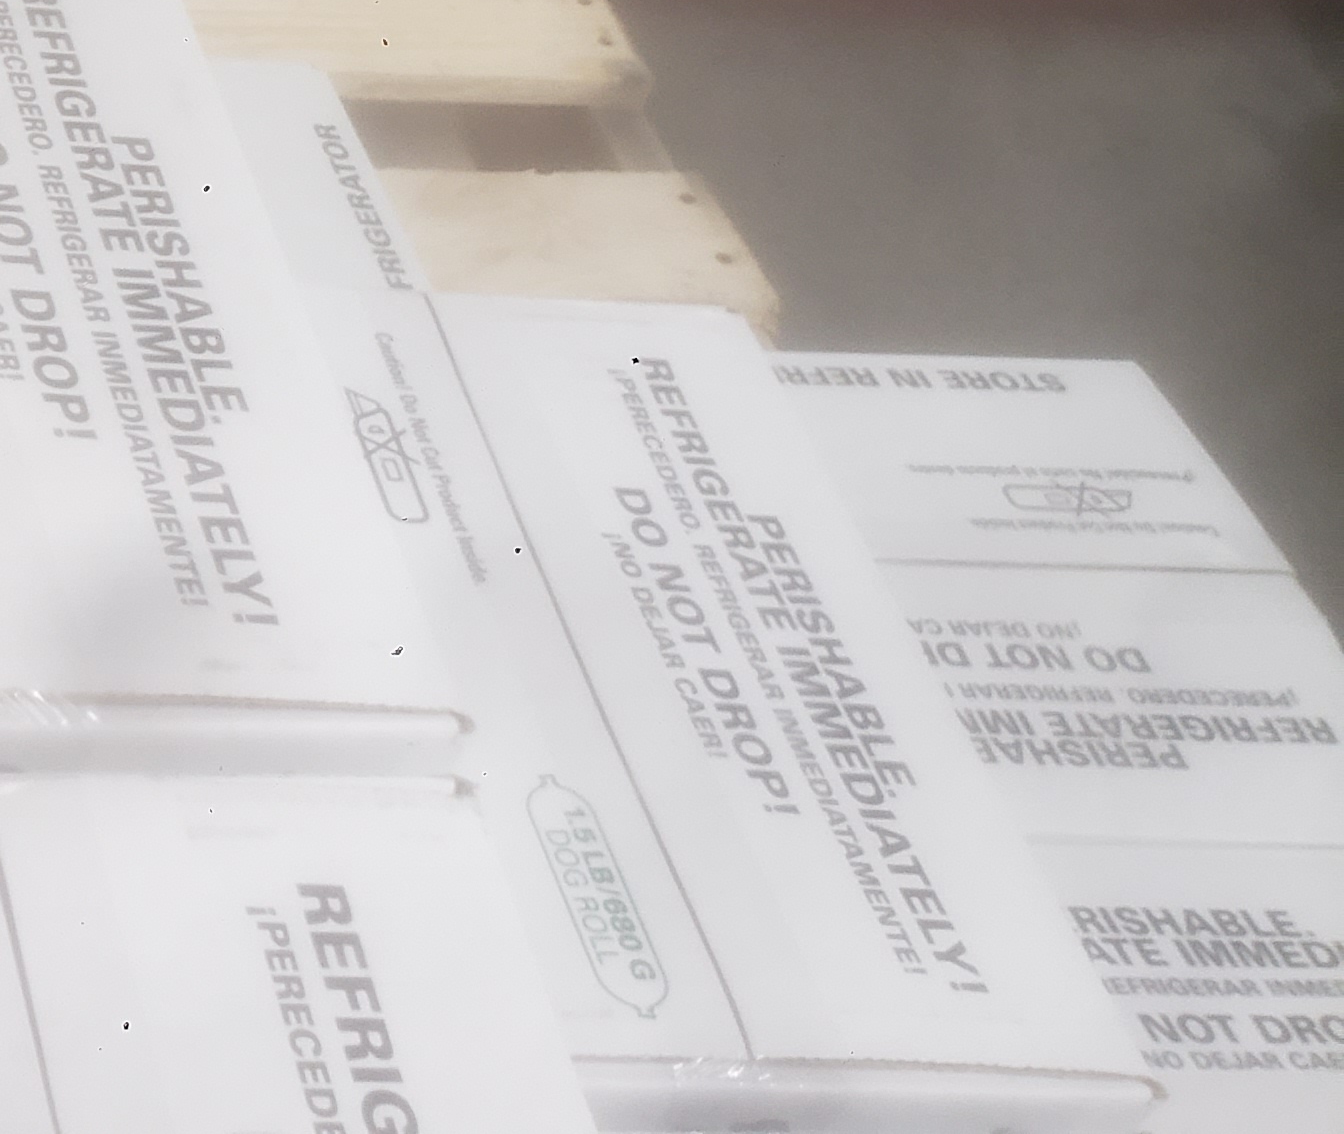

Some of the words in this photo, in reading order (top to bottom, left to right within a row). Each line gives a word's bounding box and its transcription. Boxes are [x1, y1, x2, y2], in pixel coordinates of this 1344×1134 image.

[10, 287, 99, 440] DROP!
[37, 164, 111, 323] REFRIGERAR
[90, 330, 209, 608] INMEDIATAMENTE!
[885, 366, 933, 391] IN
[945, 368, 1067, 393] STORE
[112, 267, 280, 626] IMMEDIATELY!
[613, 486, 669, 548] DO
[648, 562, 722, 655] NOT
[697, 667, 801, 816] DROP!
[630, 585, 686, 669] DEJAR
[673, 677, 729, 759] CAER!
[640, 357, 799, 631] REFRIGERATE
[775, 645, 990, 994] IMMEDIATELY!
[948, 618, 1031, 638] DEJAR
[986, 642, 1074, 672] NOT
[1082, 644, 1152, 674] DO
[693, 543, 786, 701] REFRIGERAR
[772, 708, 928, 975] INMEDIATAMENTE!
[1042, 709, 1339, 745] REFRIGERATE
[545, 829, 589, 888] DOG
[573, 895, 620, 965] ROLL
[582, 850, 644, 952] LB/680
[629, 958, 657, 981] G
[1067, 906, 1316, 937] RISHABLE.
[1137, 1012, 1239, 1044] NOT
